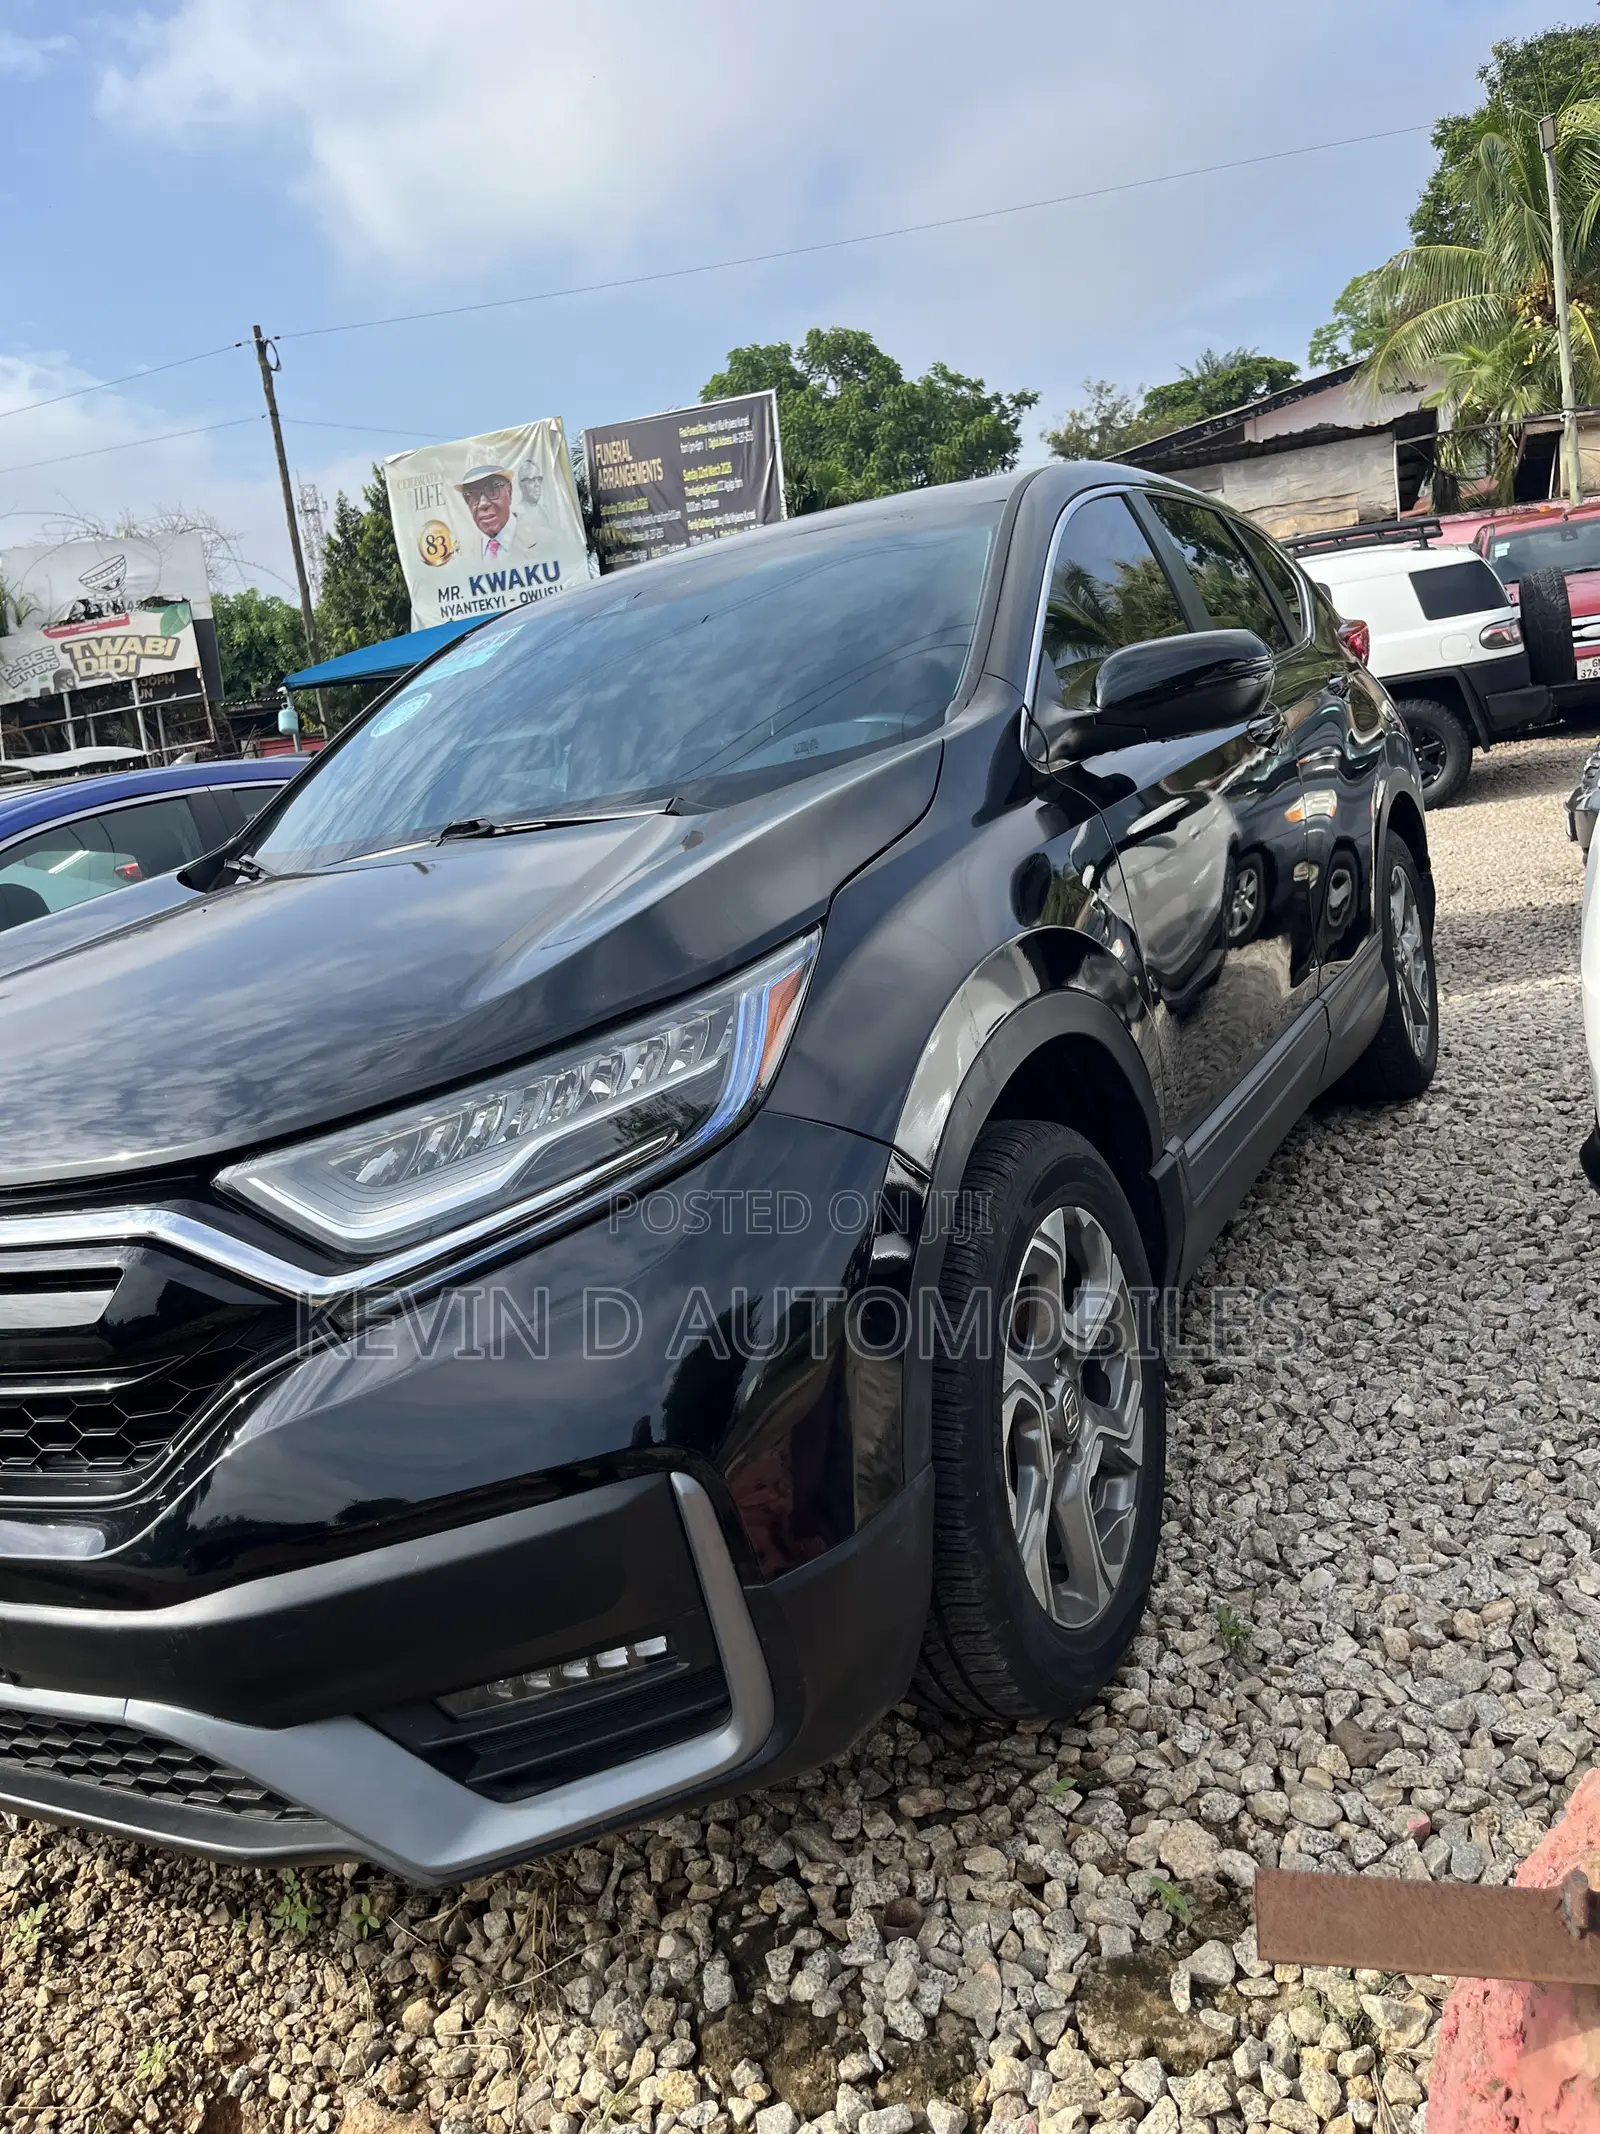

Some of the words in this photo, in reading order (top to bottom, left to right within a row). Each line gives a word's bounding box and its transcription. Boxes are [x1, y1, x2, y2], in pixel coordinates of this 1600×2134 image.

[595, 439, 633, 467] FUNERAL
[597, 457, 664, 491] ARRANGEMENTS
[413, 482, 447, 511] LIFE
[425, 534, 448, 558] 83
[437, 585, 464, 603] MR.
[468, 560, 561, 597] KWAKU
[439, 597, 507, 619] NYANTEKYI
[63, 635, 179, 661] TWABI
[0, 646, 54, 681] P-BEE
[7, 658, 60, 689] BITTERS
[76, 654, 139, 678] DIDI
